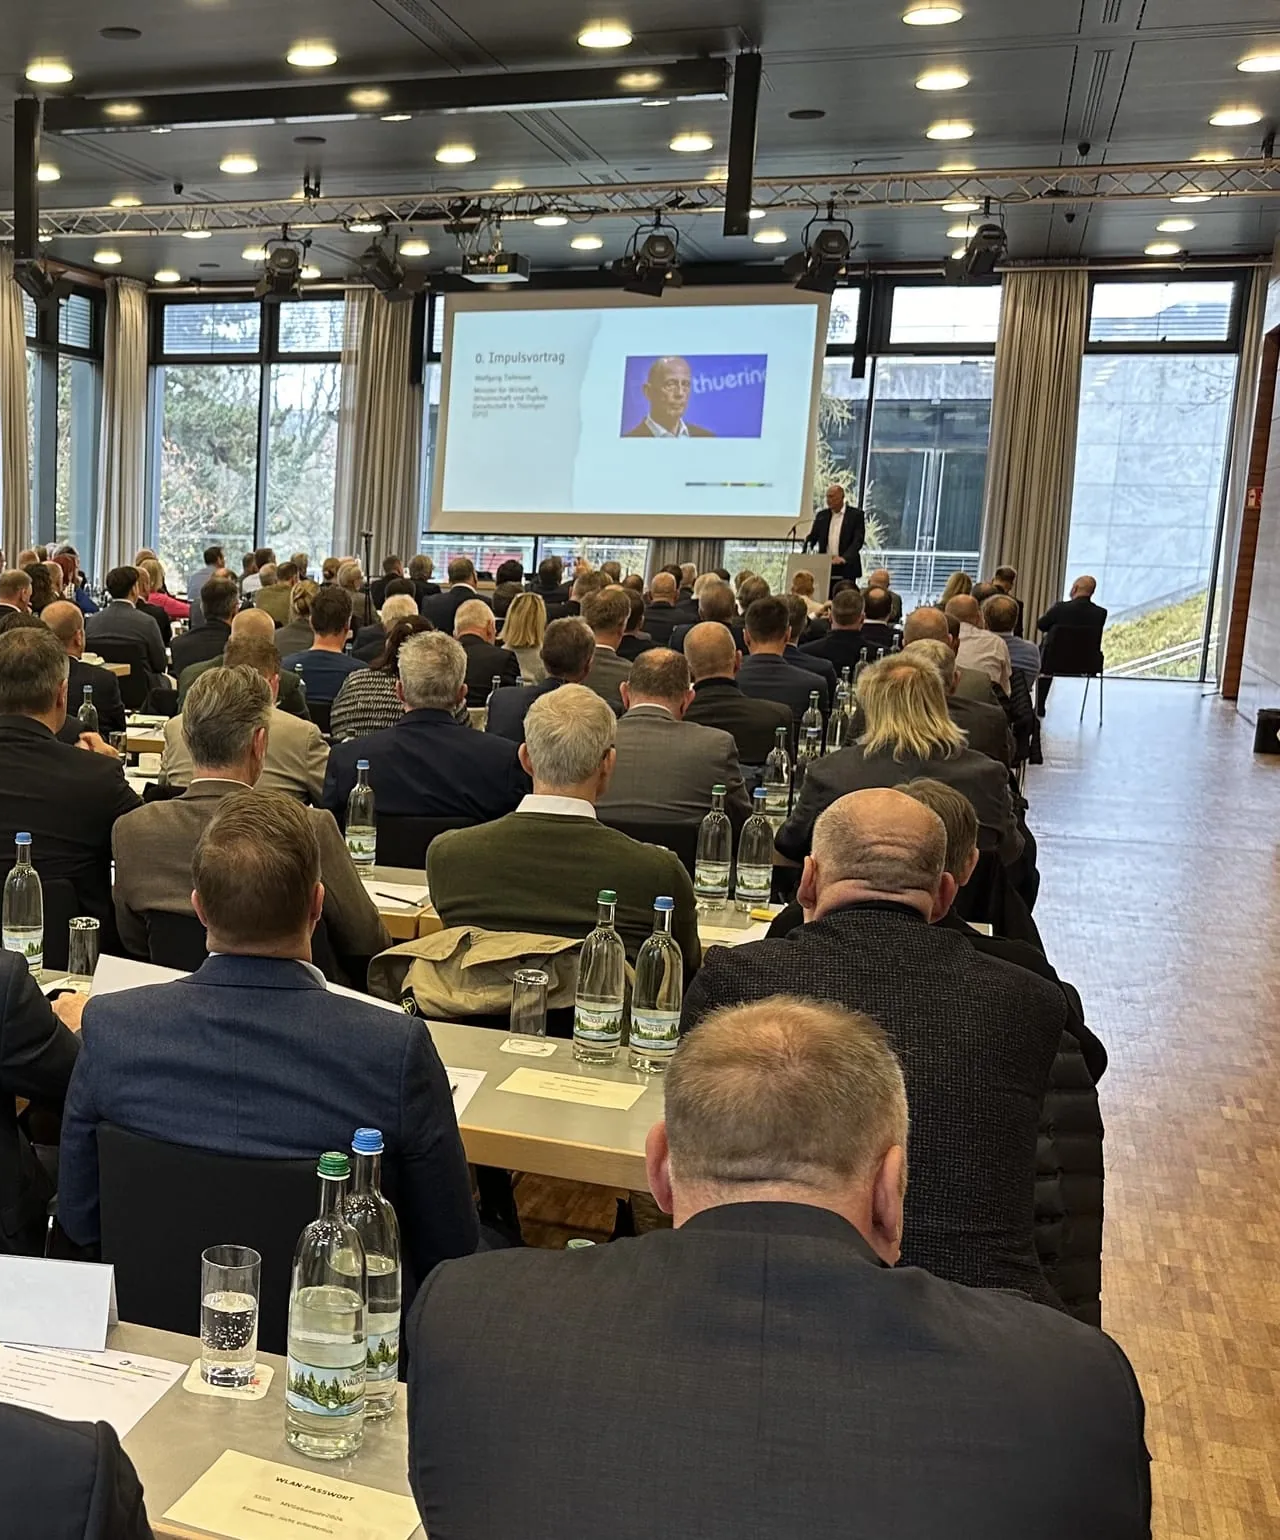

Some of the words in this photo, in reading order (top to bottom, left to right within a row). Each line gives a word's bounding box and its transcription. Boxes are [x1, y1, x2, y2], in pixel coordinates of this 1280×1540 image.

[475, 353, 485, 364] 0.
[488, 352, 565, 365] Impulsvortrag
[276, 1476, 355, 1502] WLAN-PASSWORT
